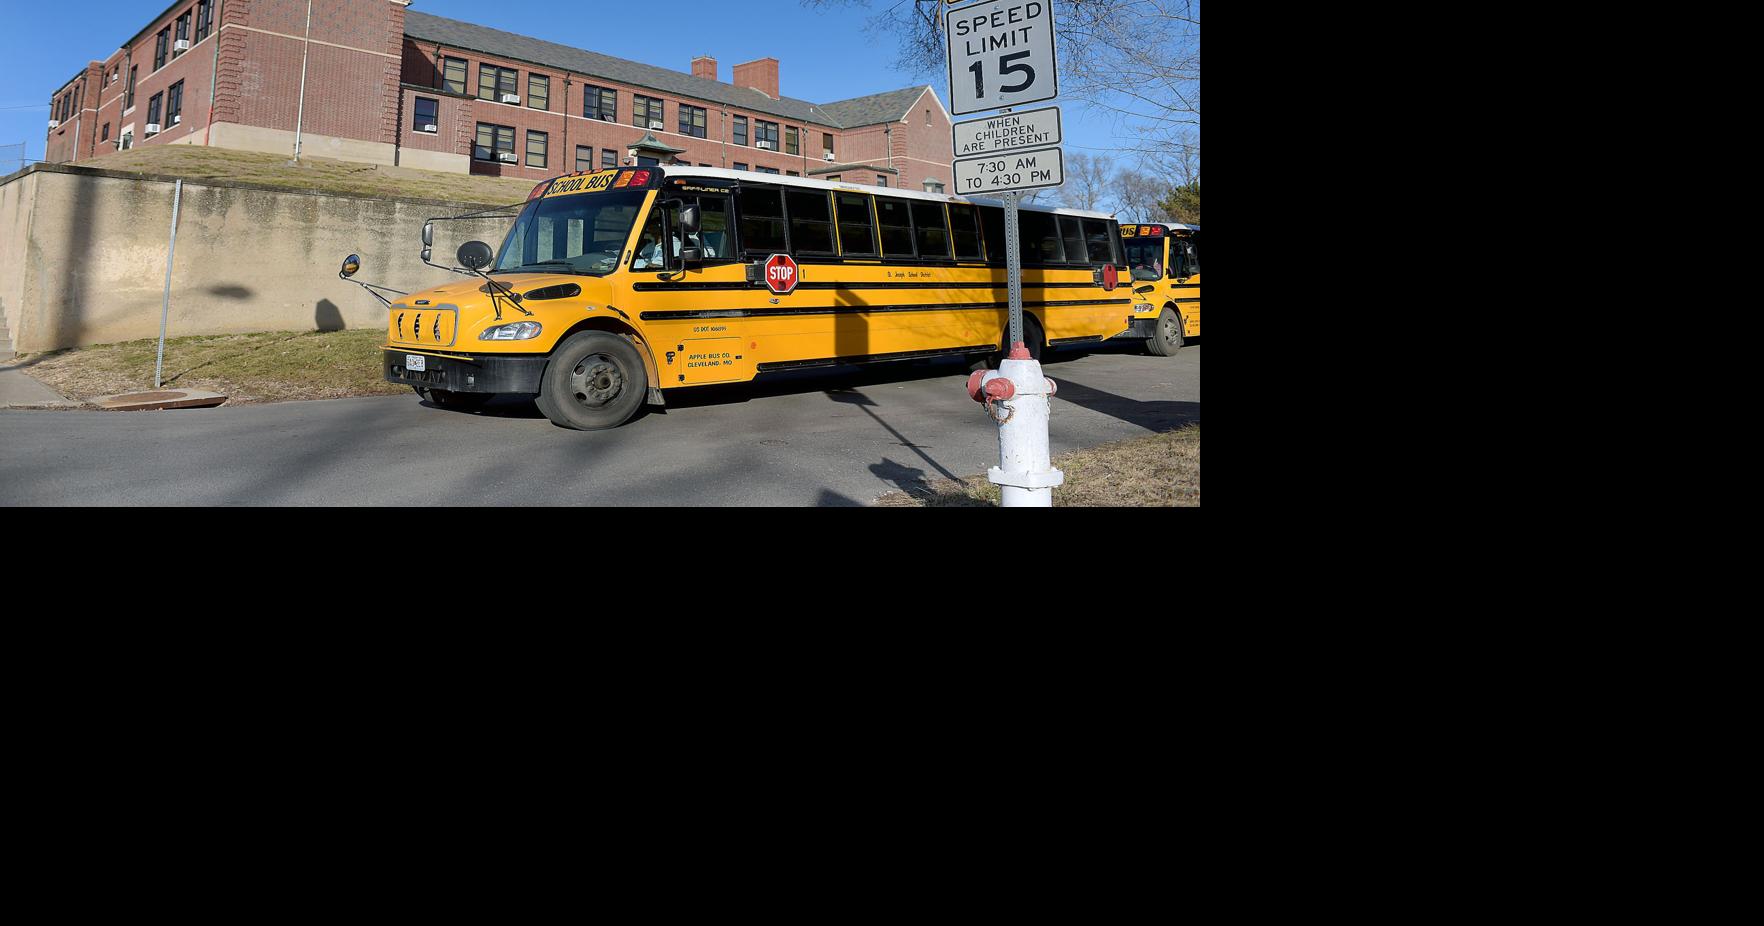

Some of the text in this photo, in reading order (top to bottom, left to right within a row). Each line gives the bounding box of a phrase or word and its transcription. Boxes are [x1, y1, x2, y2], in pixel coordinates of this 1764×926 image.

[956, 2, 1042, 36] SPEED
[966, 26, 1033, 56] LIMIT
[968, 50, 1036, 99] 15
[975, 124, 1035, 141] CHILDREN
[987, 117, 1020, 129] WHEN
[963, 132, 1050, 152] ARE PRESENT
[977, 157, 1037, 174] 7:30 AM
[547, 174, 614, 195] SCHOOL BUS
[966, 169, 1051, 189] TO 4:30 PM
[1120, 227, 1135, 236] US
[770, 266, 793, 280] STOP
